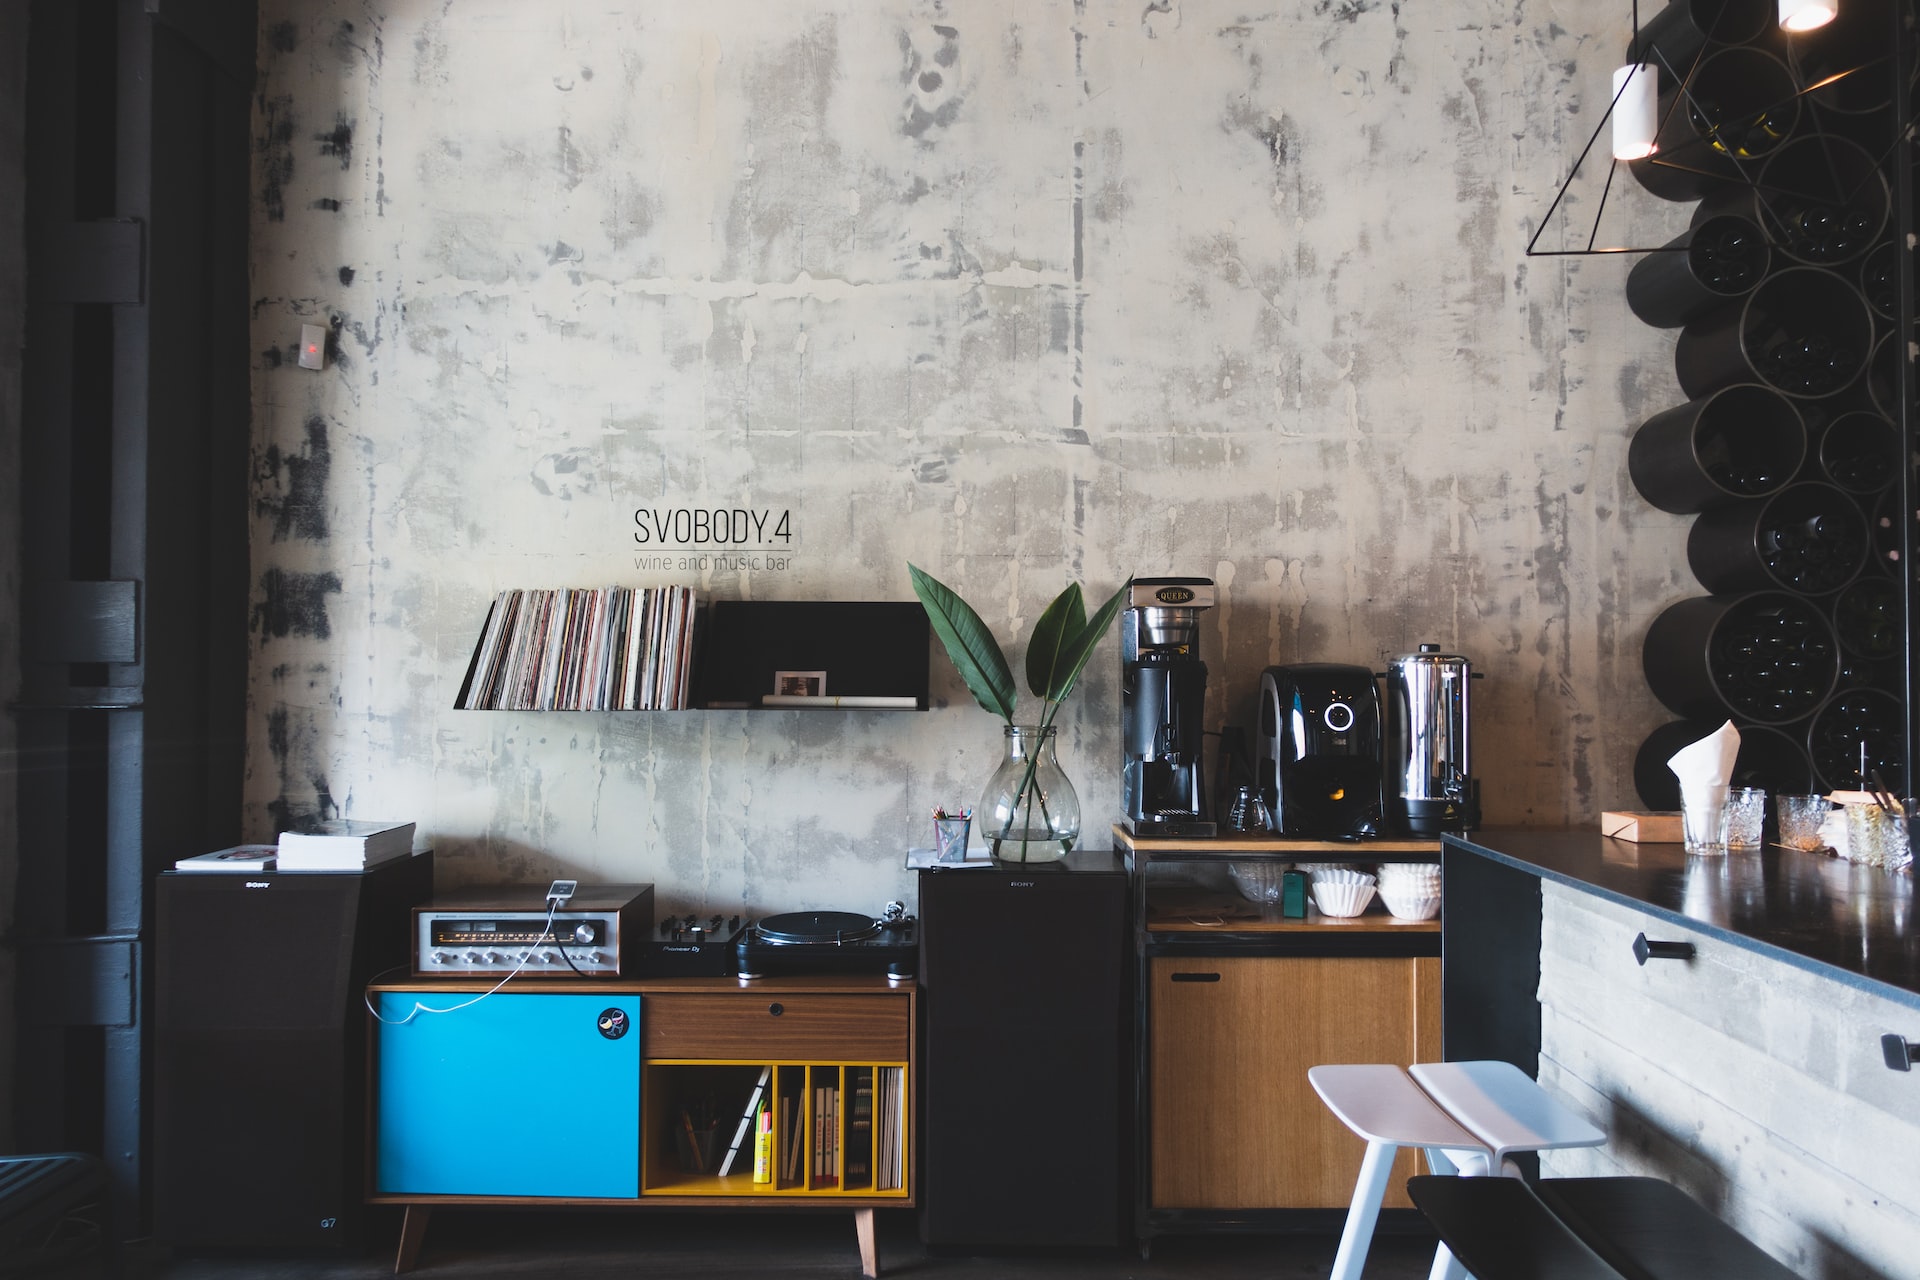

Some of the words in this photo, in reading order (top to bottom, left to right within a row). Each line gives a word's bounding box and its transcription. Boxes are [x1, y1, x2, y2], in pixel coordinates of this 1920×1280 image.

[634, 508, 792, 544] SVOBODY.4
[634, 554, 673, 571] wine
[678, 554, 708, 571] and
[714, 554, 760, 571] music
[766, 554, 792, 571] bar
[1160, 591, 1189, 600] QUEEN
